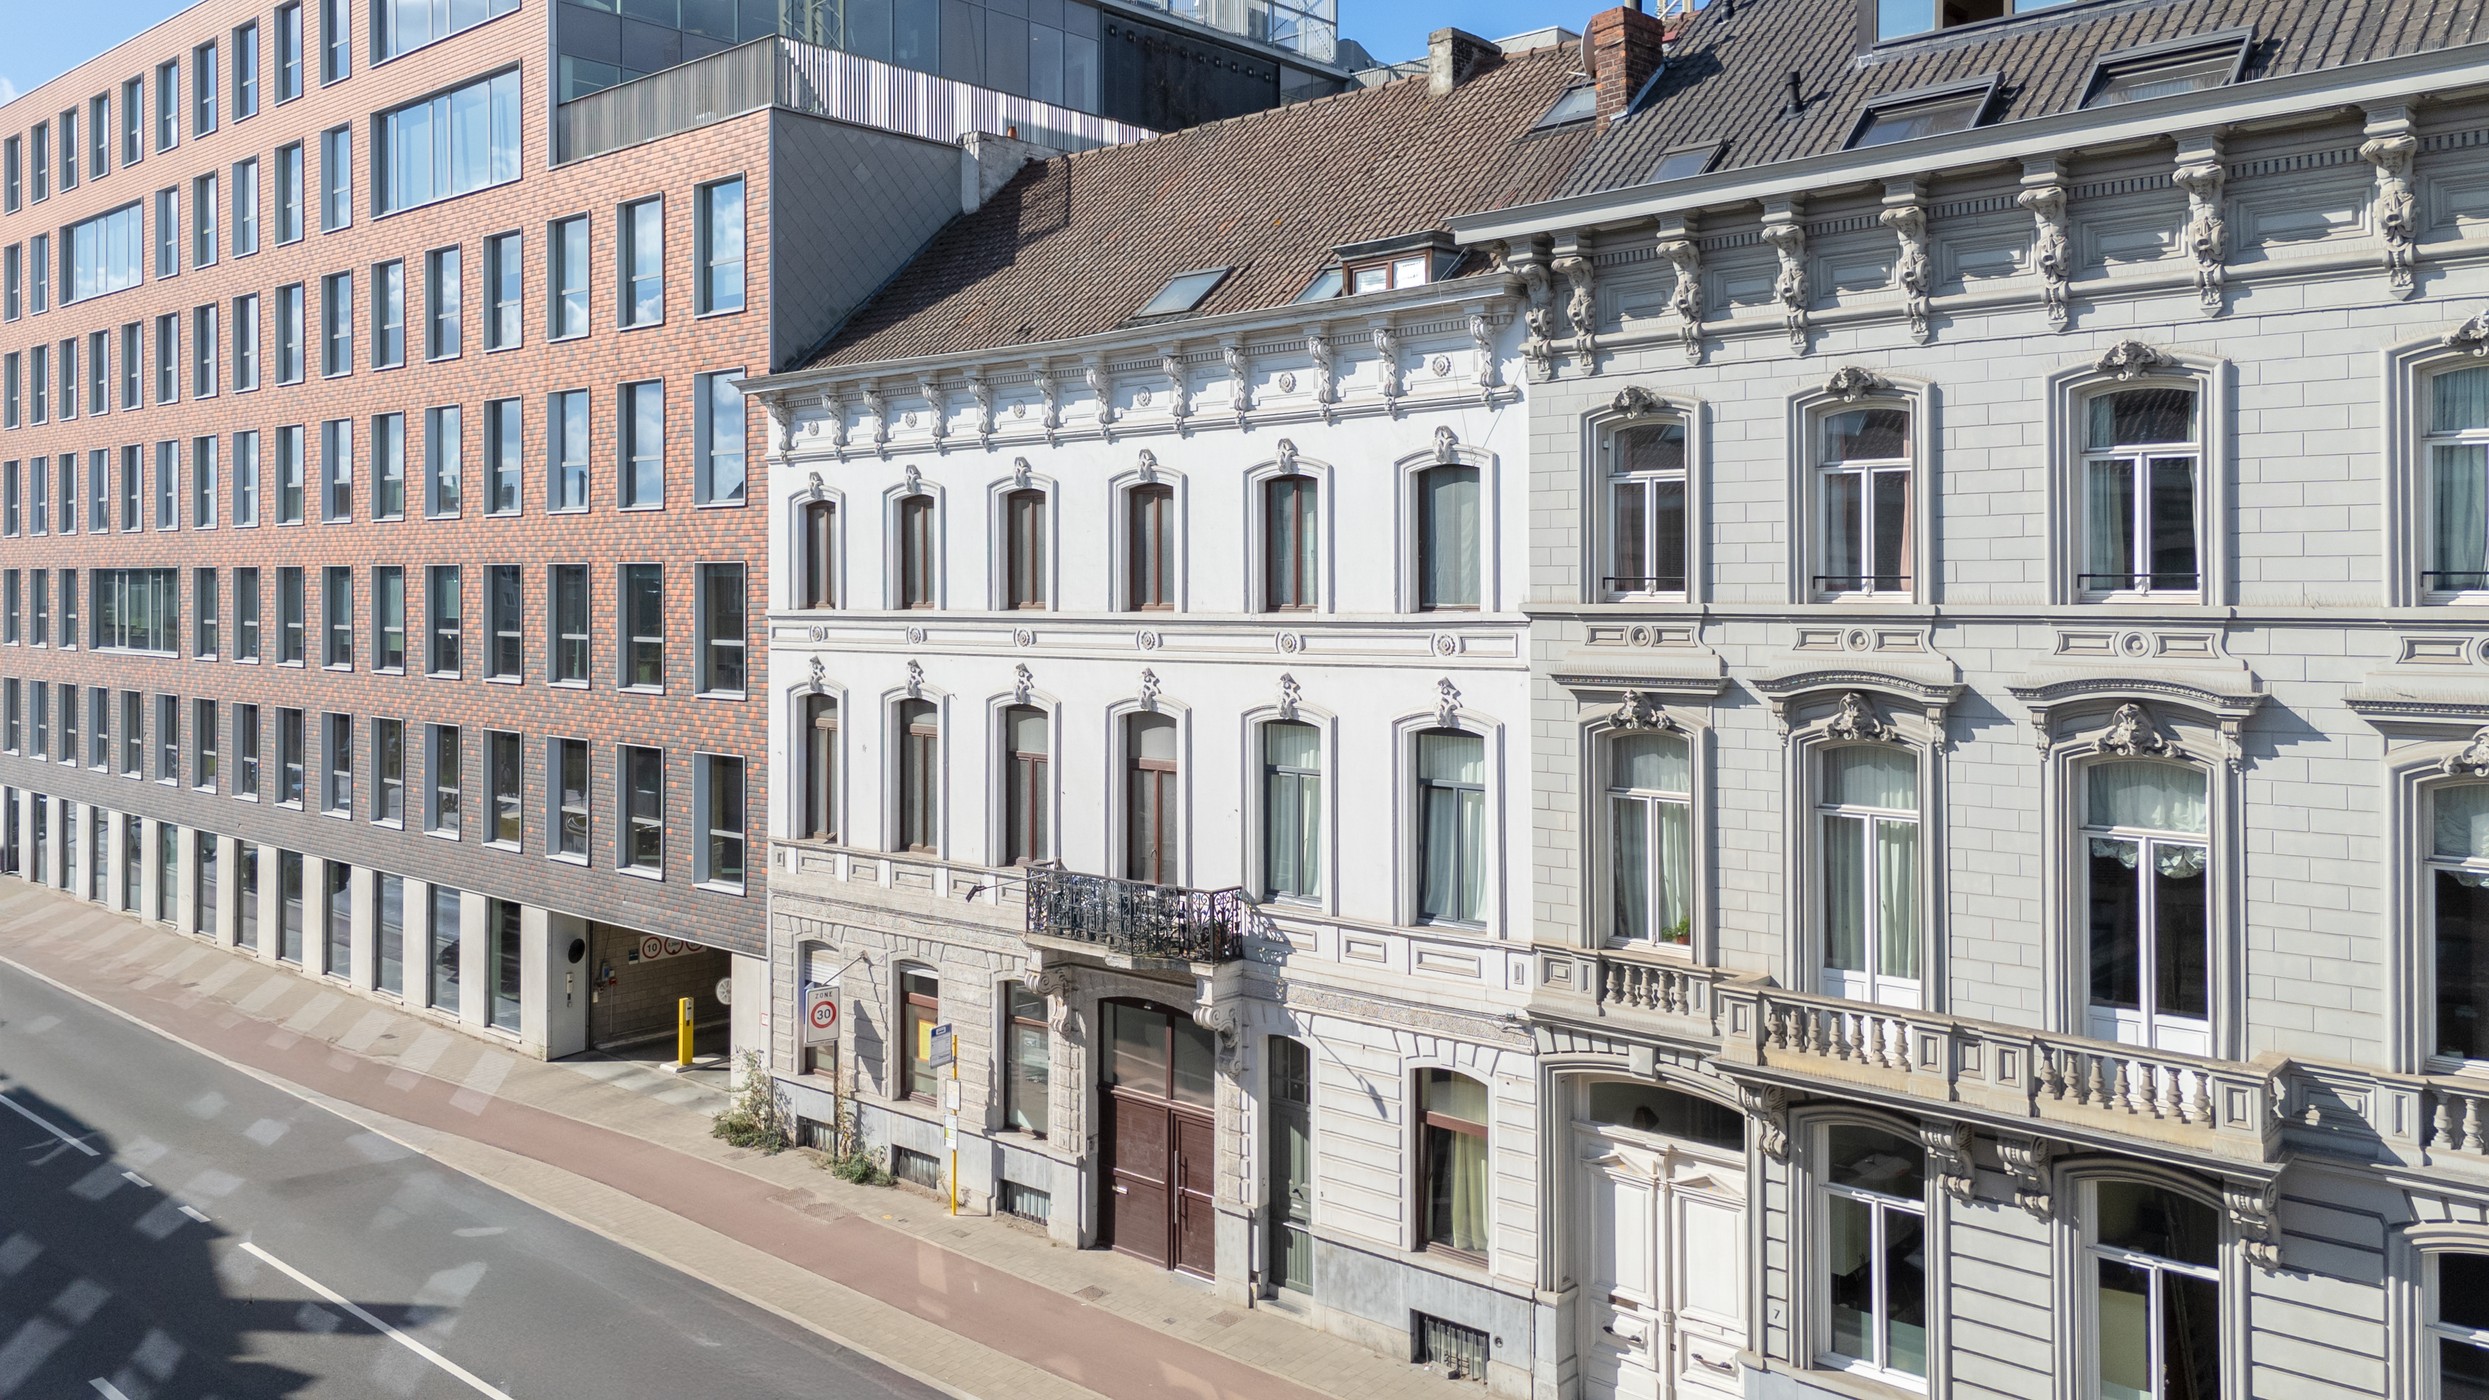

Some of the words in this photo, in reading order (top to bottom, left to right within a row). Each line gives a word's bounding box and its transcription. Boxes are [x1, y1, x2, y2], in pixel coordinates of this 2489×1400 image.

[647, 943, 657, 952] 10
[815, 991, 833, 999] ZONE
[817, 1009, 831, 1020] 30
[1774, 1309, 1780, 1319] 7
